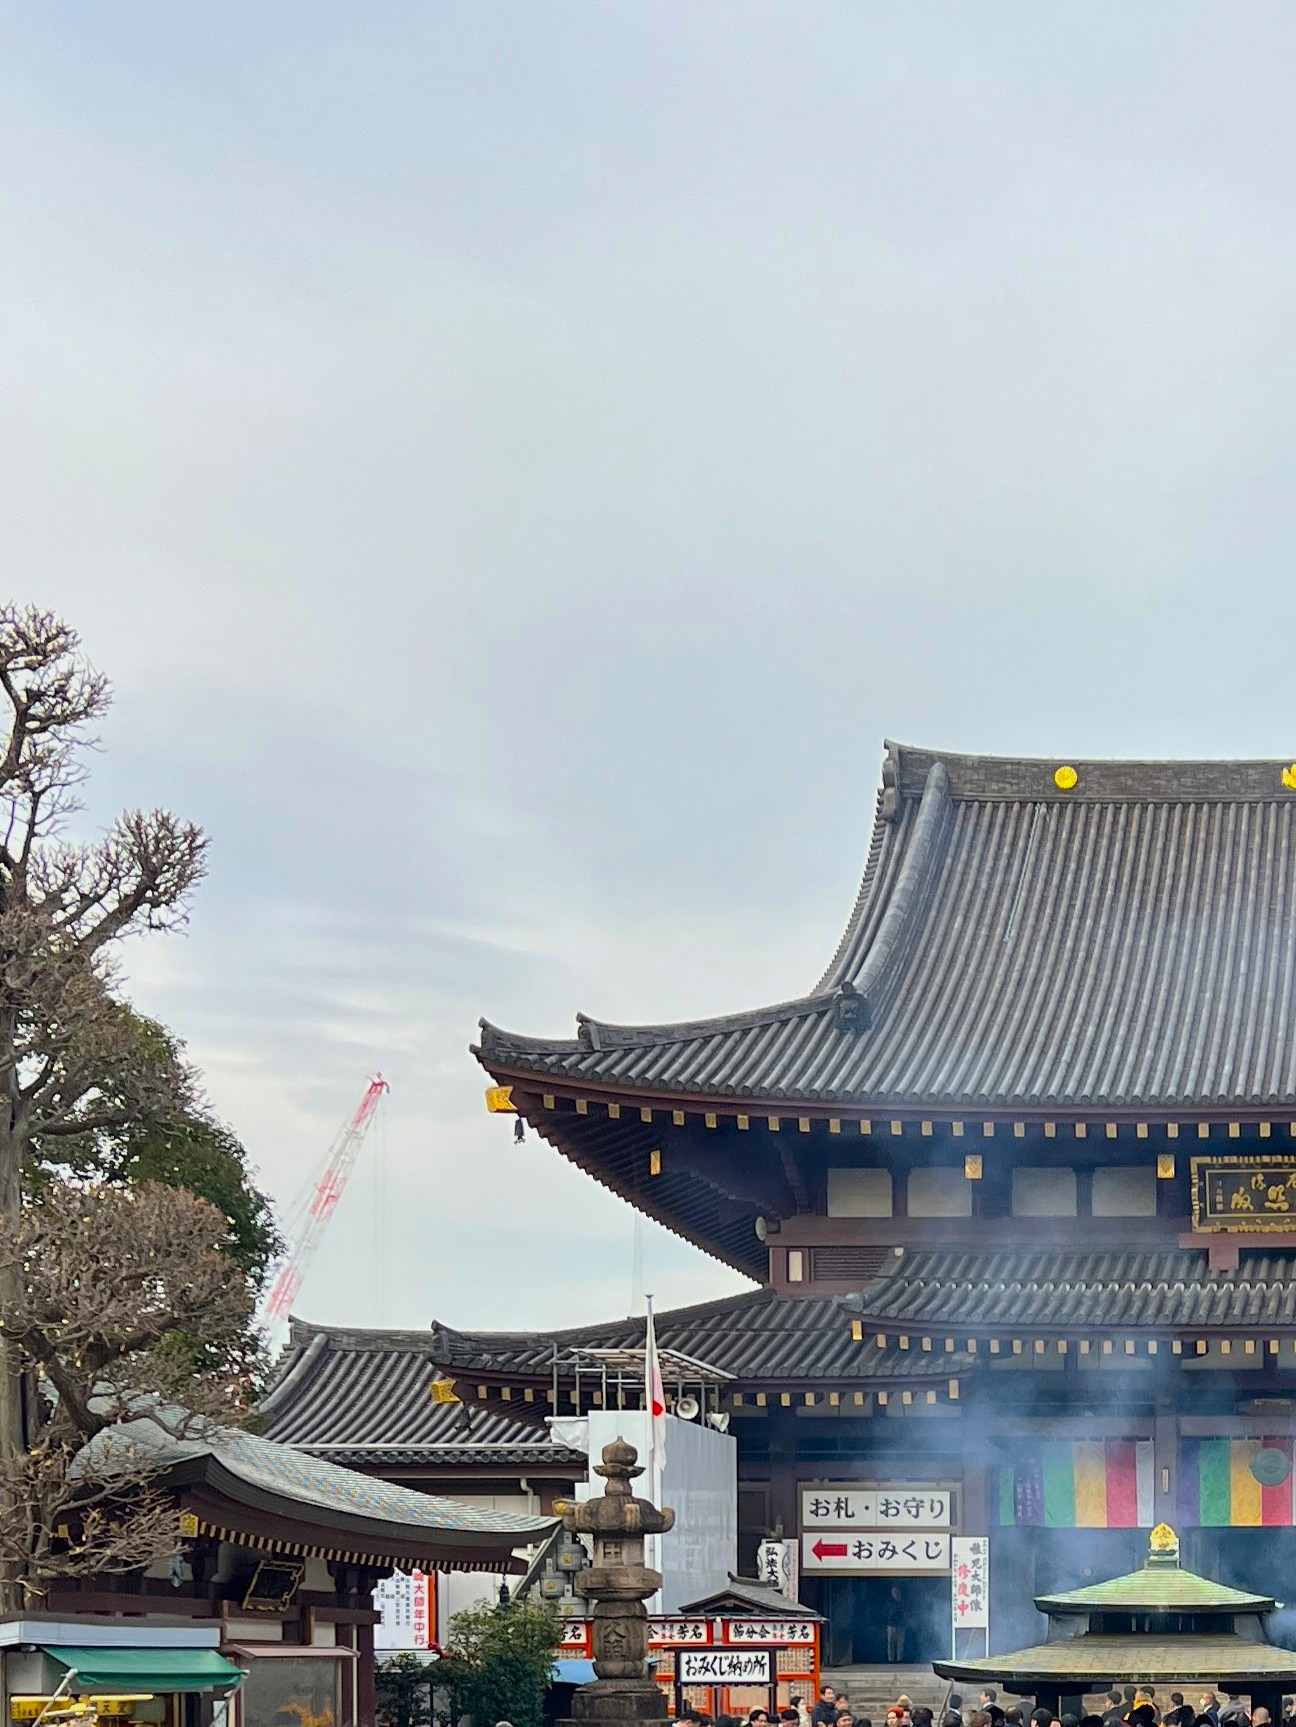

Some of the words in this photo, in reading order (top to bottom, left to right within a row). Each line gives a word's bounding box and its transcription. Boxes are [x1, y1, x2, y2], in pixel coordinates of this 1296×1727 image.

[809, 1497, 944, 1519] お札・お守り
[852, 1540, 942, 1561] おみくじ
[685, 1654, 767, 1678] おみくじ納め所
